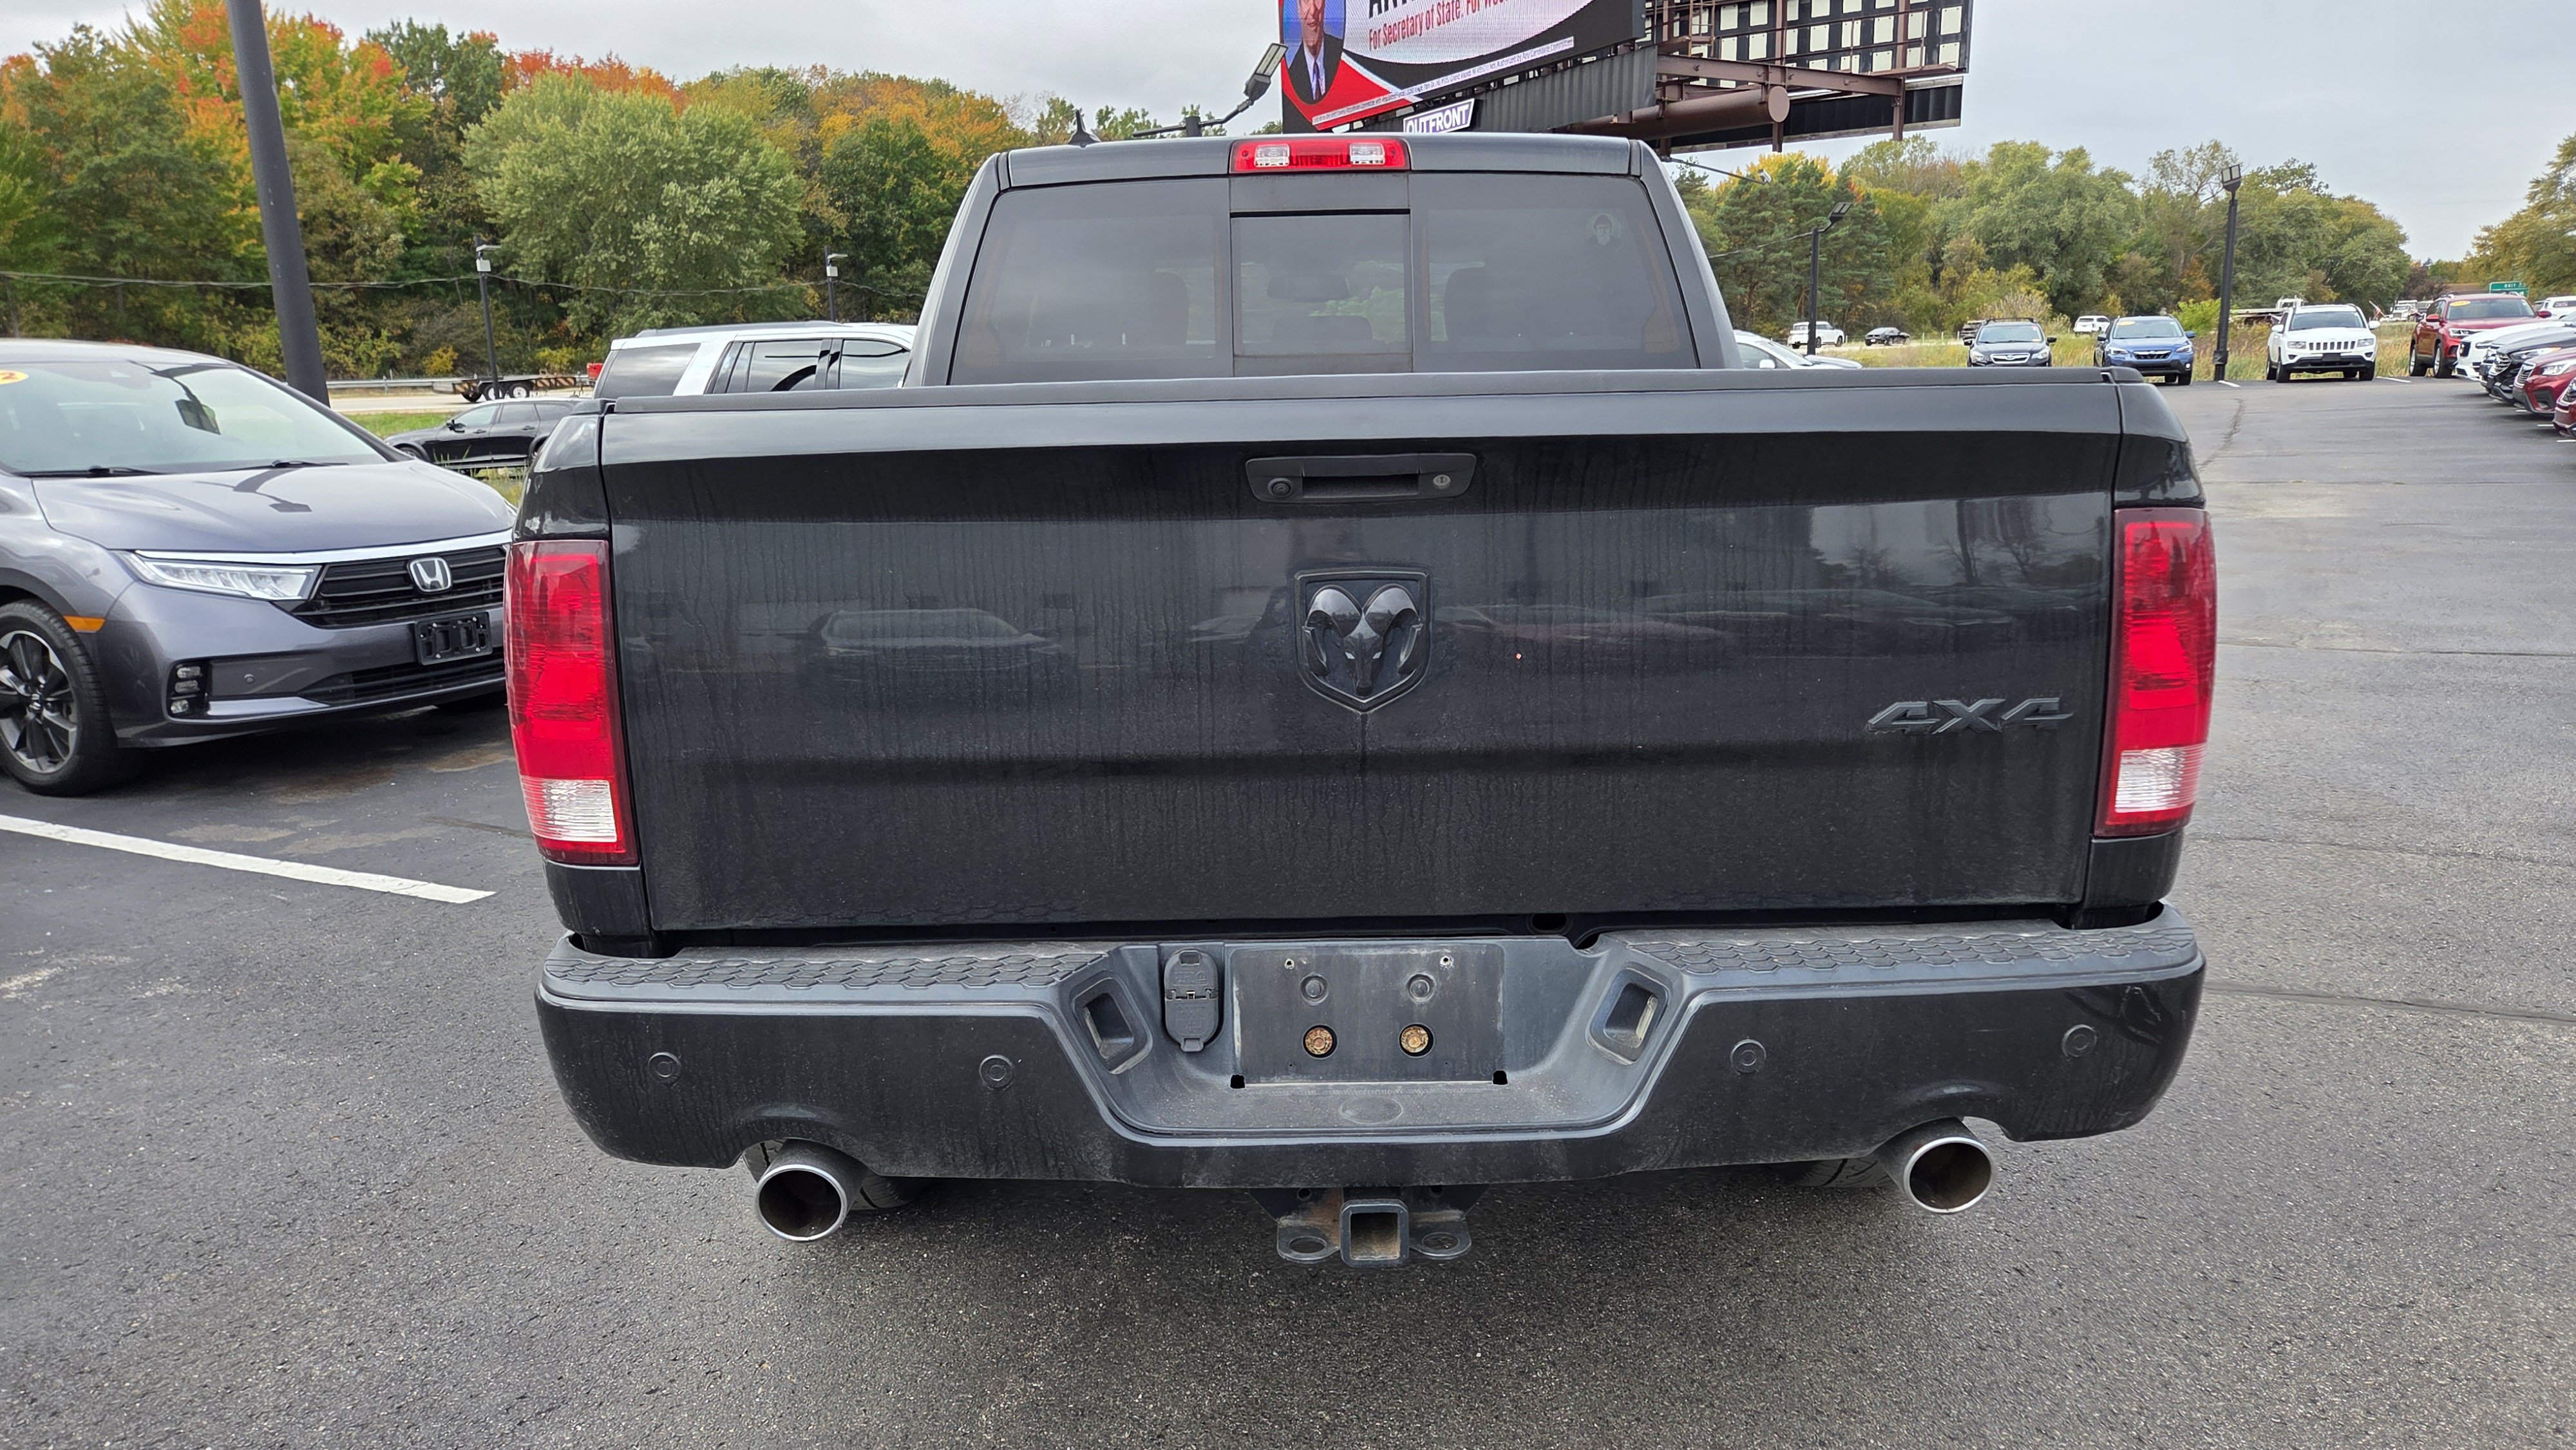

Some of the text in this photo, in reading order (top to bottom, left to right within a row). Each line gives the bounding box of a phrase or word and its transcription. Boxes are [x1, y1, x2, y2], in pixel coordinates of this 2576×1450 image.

[1369, 28, 1381, 51] For
[1383, 12, 1423, 37] Secretary
[1425, 4, 1435, 30] of
[1406, 104, 1470, 133] OUTFRONT
